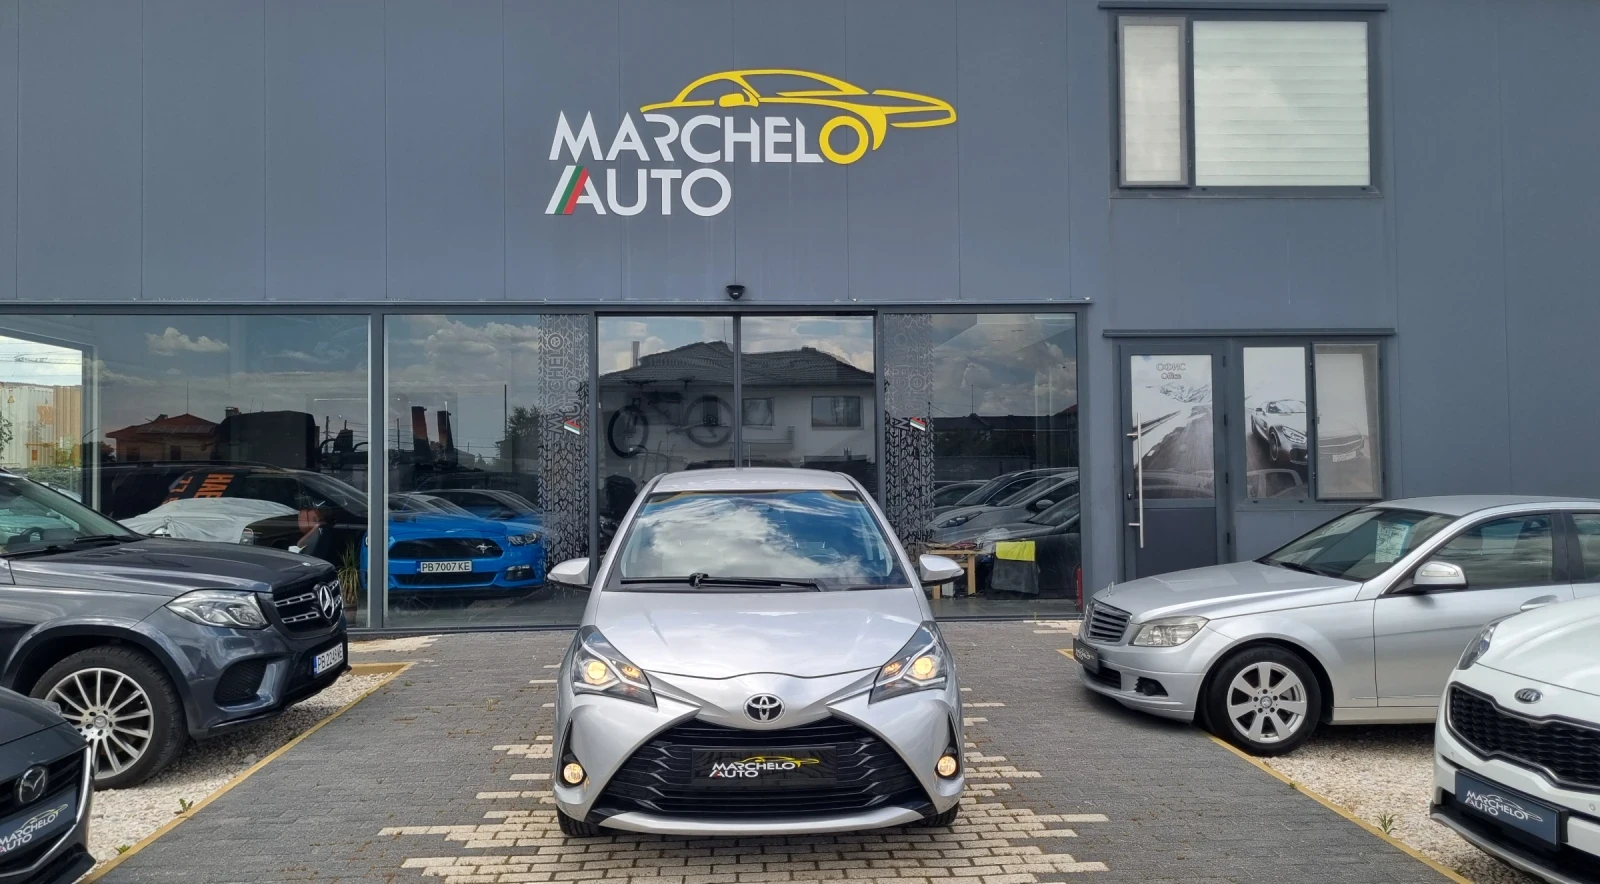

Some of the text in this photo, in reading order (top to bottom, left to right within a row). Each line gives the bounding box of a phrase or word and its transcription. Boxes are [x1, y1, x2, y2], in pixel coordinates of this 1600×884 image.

[548, 110, 869, 165] MARCHELO
[544, 165, 732, 217] AUTO
[1156, 363, 1186, 371] ОФИС
[547, 333, 564, 434] MARCHELO
[563, 376, 581, 435] AUTO
[422, 561, 470, 571] PB 7007 KE
[1515, 689, 1539, 702] KIA
[709, 770, 759, 778] AUTO
[712, 762, 796, 770] MARCHELO
[1464, 796, 1499, 816] AUTO
[1466, 790, 1525, 820] MARCHELO
[0, 813, 56, 846] MARCHELO
